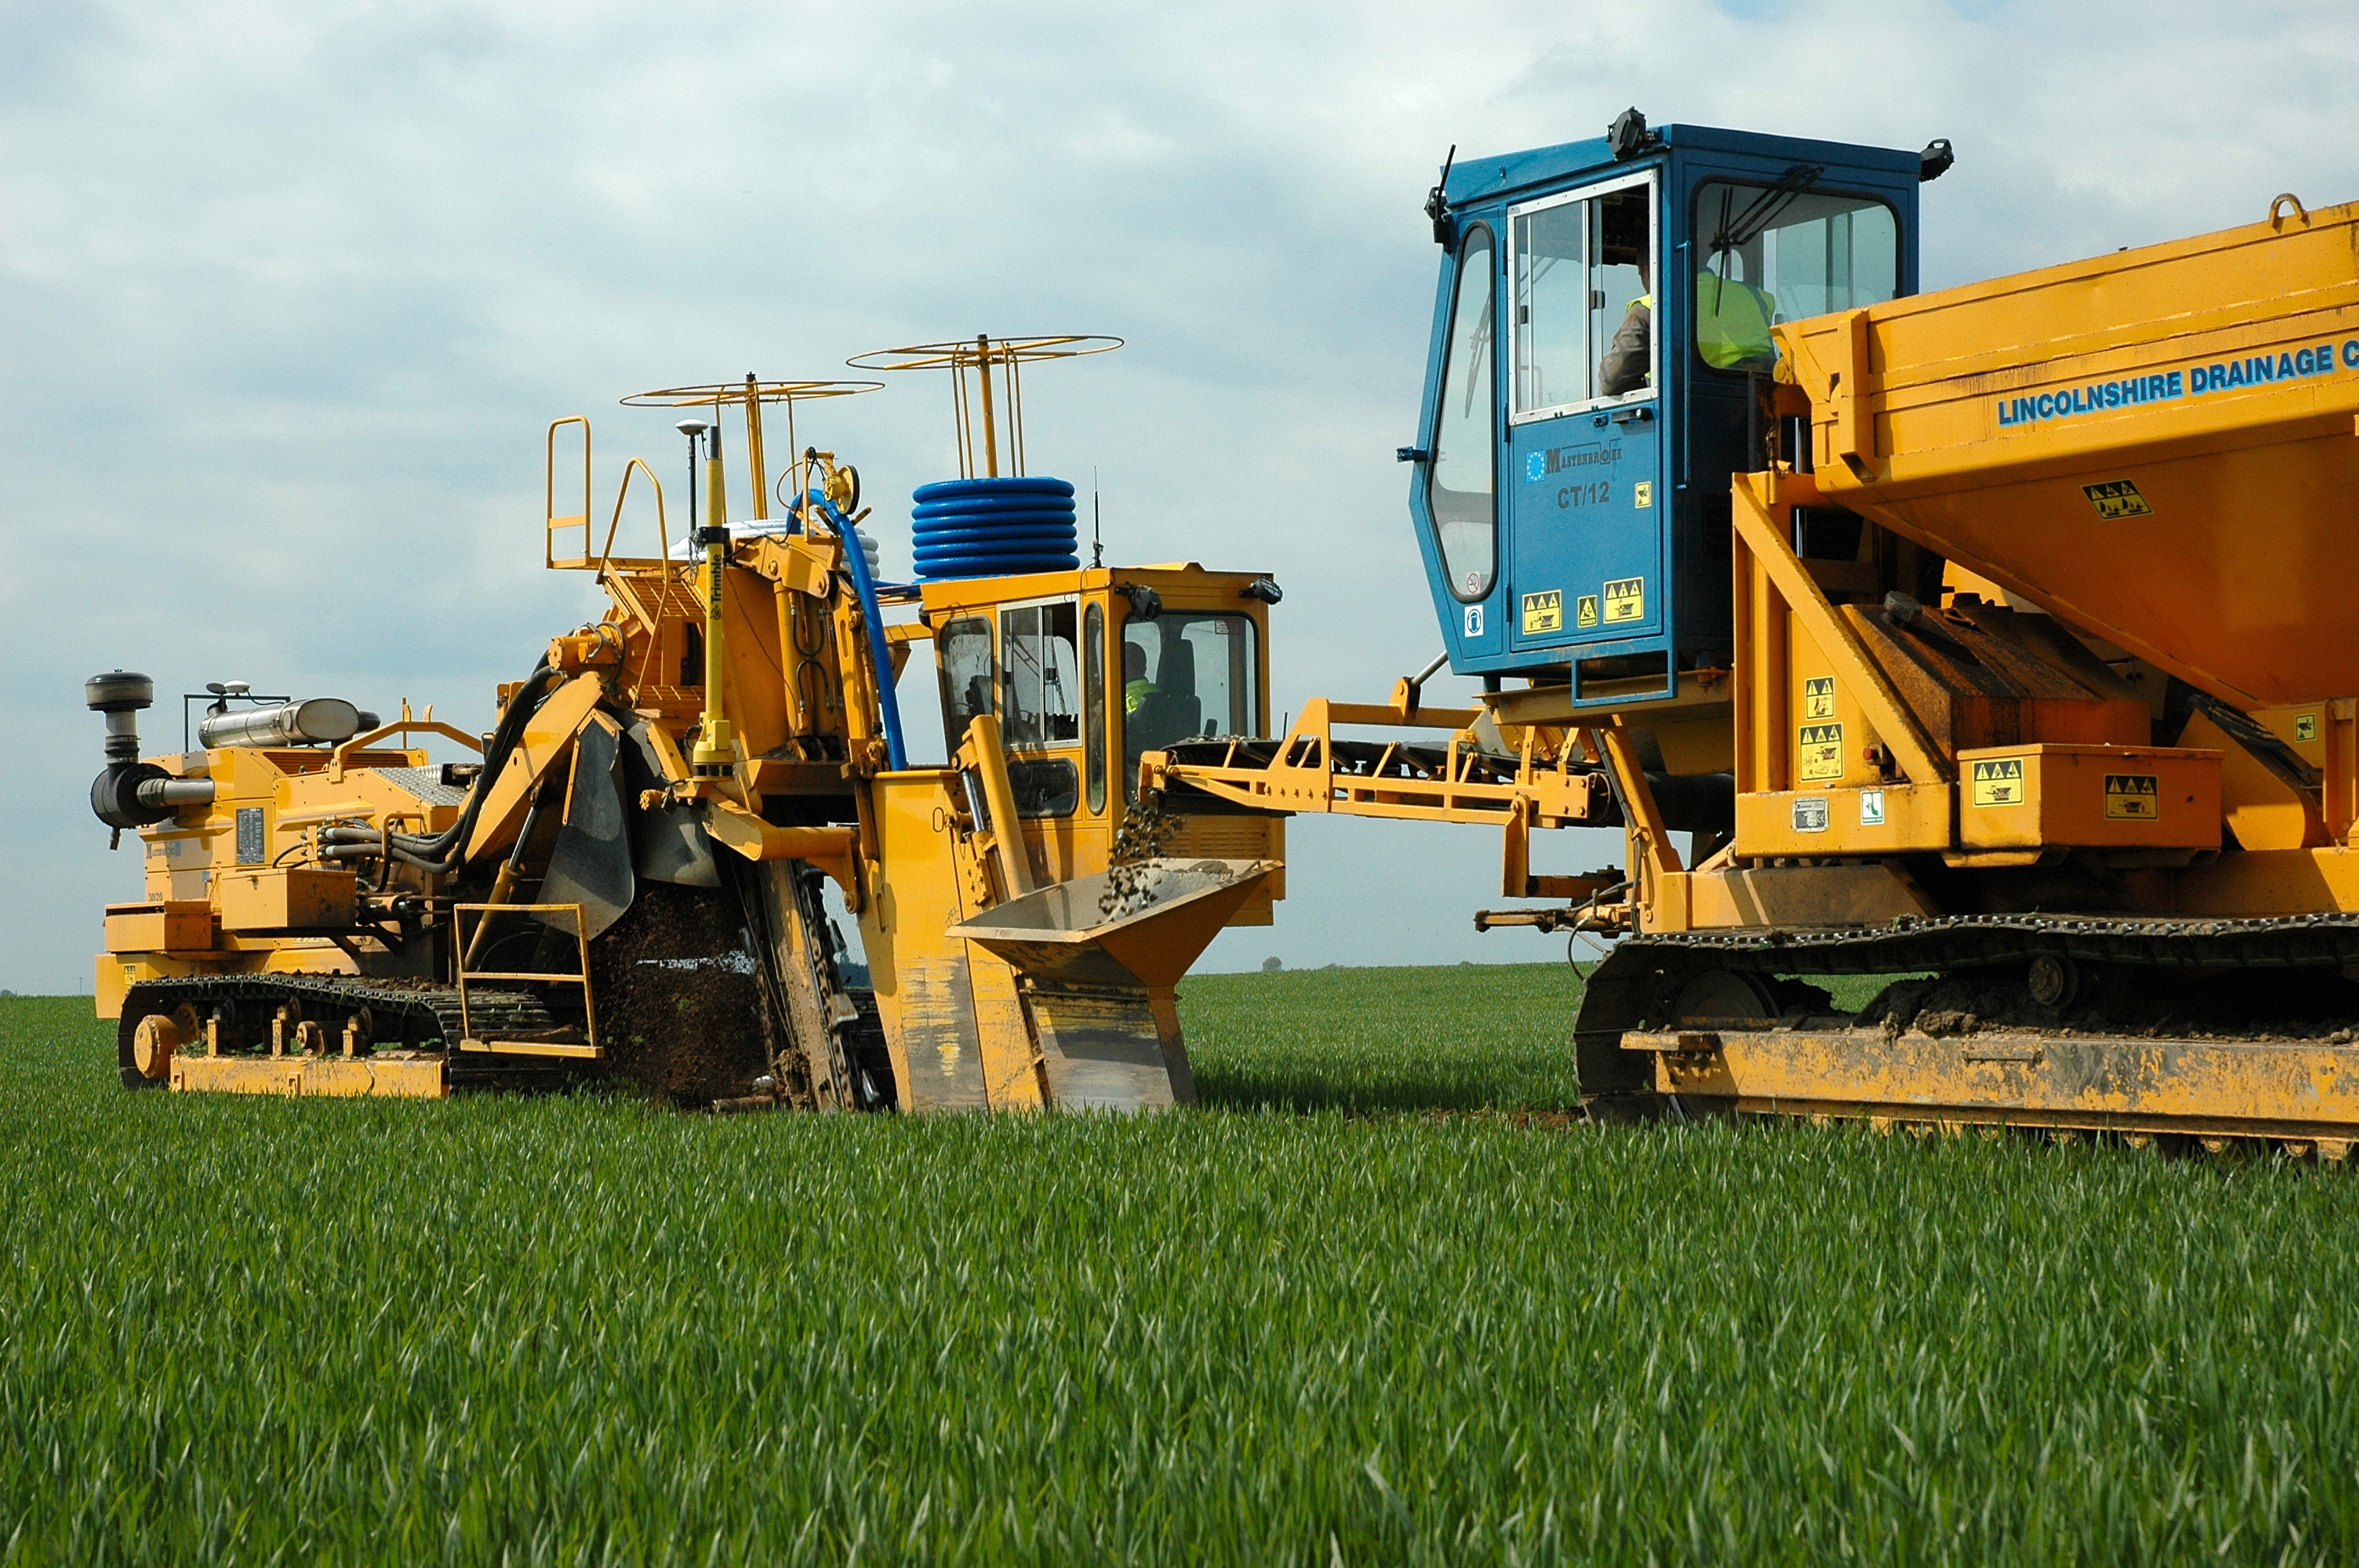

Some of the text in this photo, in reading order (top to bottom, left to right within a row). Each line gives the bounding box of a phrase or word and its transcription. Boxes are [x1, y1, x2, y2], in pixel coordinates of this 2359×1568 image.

[1997, 370, 2183, 426] LINCOLNSHIRE
[2190, 344, 2334, 395] DRAINAGE
[1558, 481, 1610, 509] CT/12
[711, 554, 722, 604] Trimble
